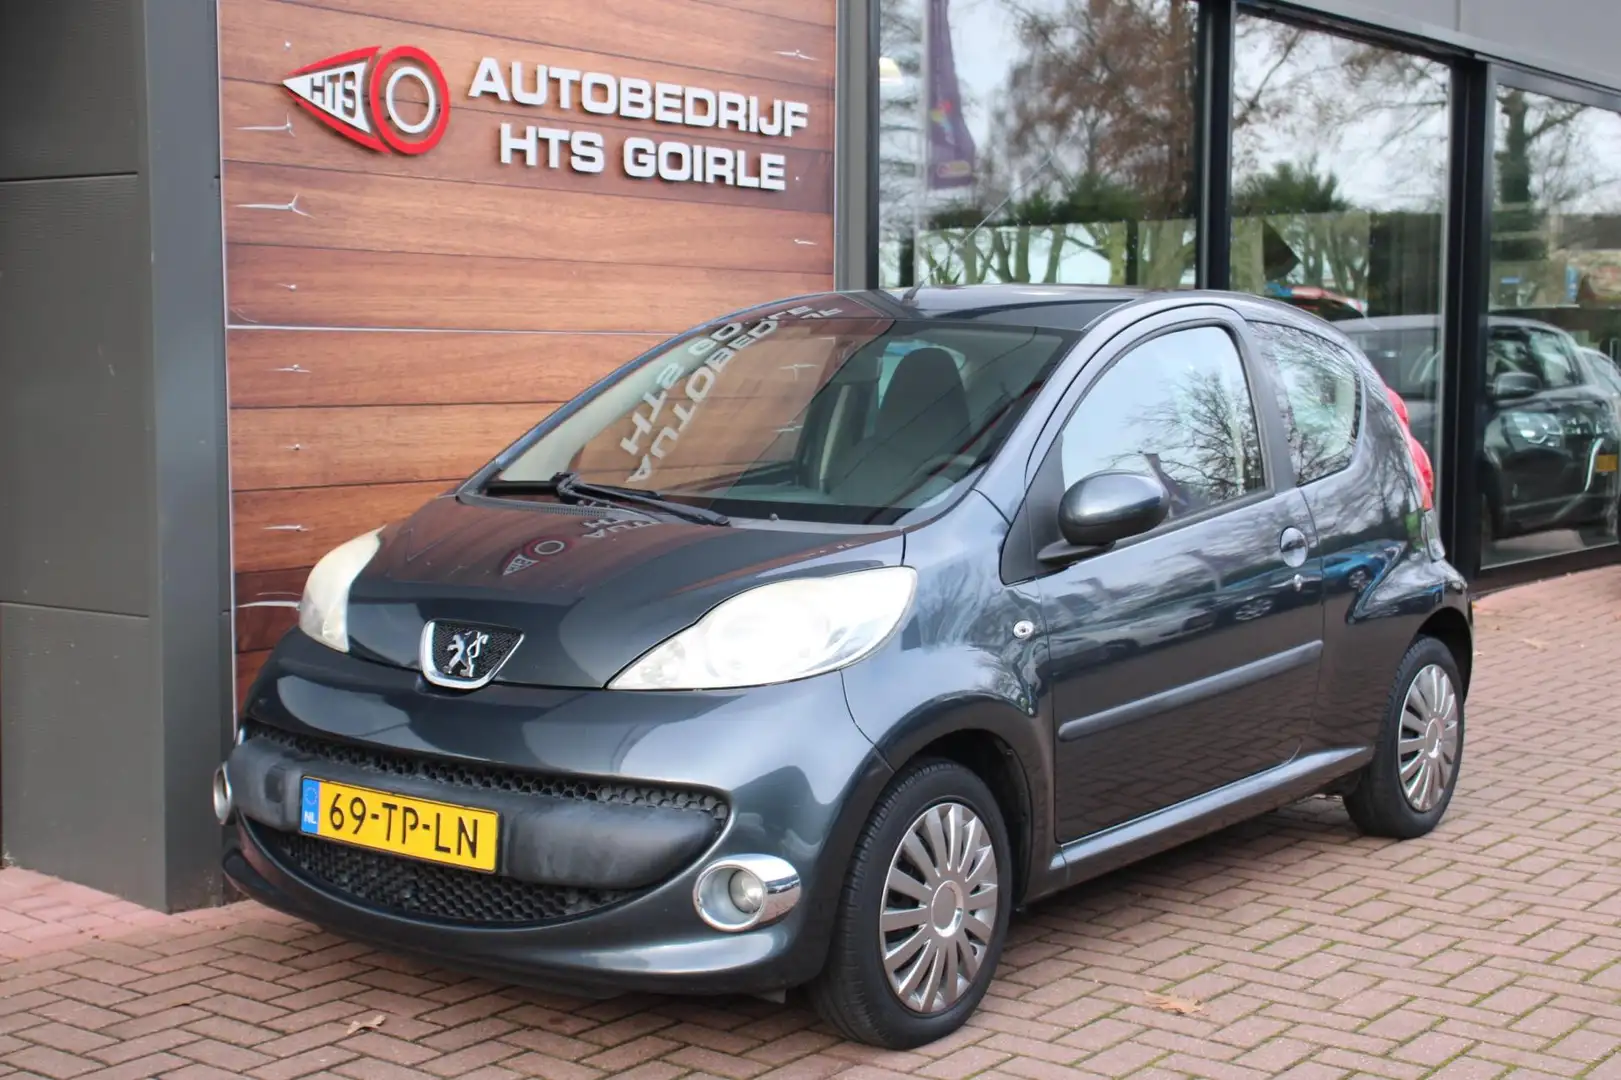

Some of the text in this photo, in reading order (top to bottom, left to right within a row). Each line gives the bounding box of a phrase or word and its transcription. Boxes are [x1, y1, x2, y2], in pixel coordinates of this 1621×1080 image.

[309, 70, 356, 119] HTS
[468, 57, 809, 137] AUTOBEDRIJF
[500, 122, 786, 191] HTS GOIRLE
[304, 811, 317, 825] NL
[329, 793, 478, 859] 69-TP-LN
